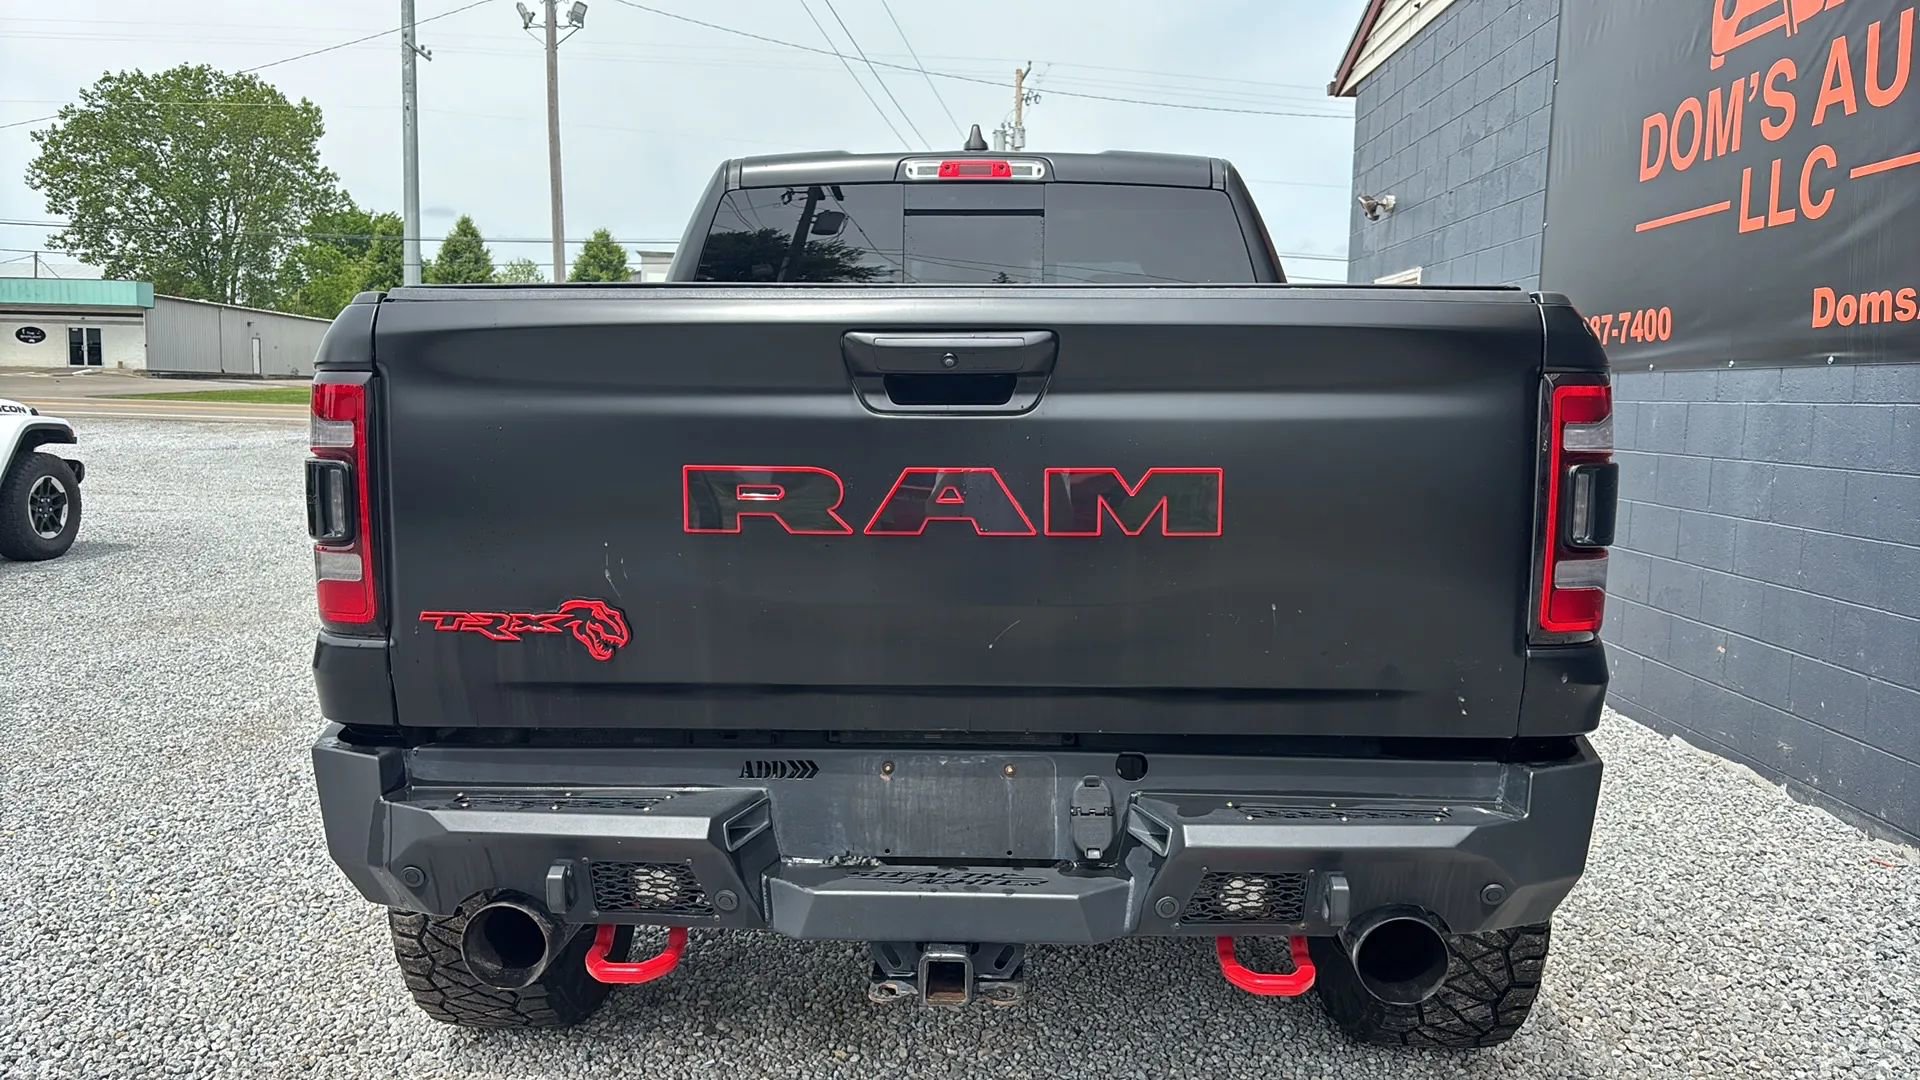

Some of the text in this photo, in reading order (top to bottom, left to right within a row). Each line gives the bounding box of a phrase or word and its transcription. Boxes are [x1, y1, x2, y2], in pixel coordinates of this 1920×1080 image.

[1640, 7, 1920, 182] DOM'S AU
[1739, 145, 1838, 233] LLC
[1584, 287, 1920, 346] 87-7400 Doms
[683, 465, 1223, 537] RAM
[419, 611, 575, 641] TRX
[739, 760, 787, 779] ADD
